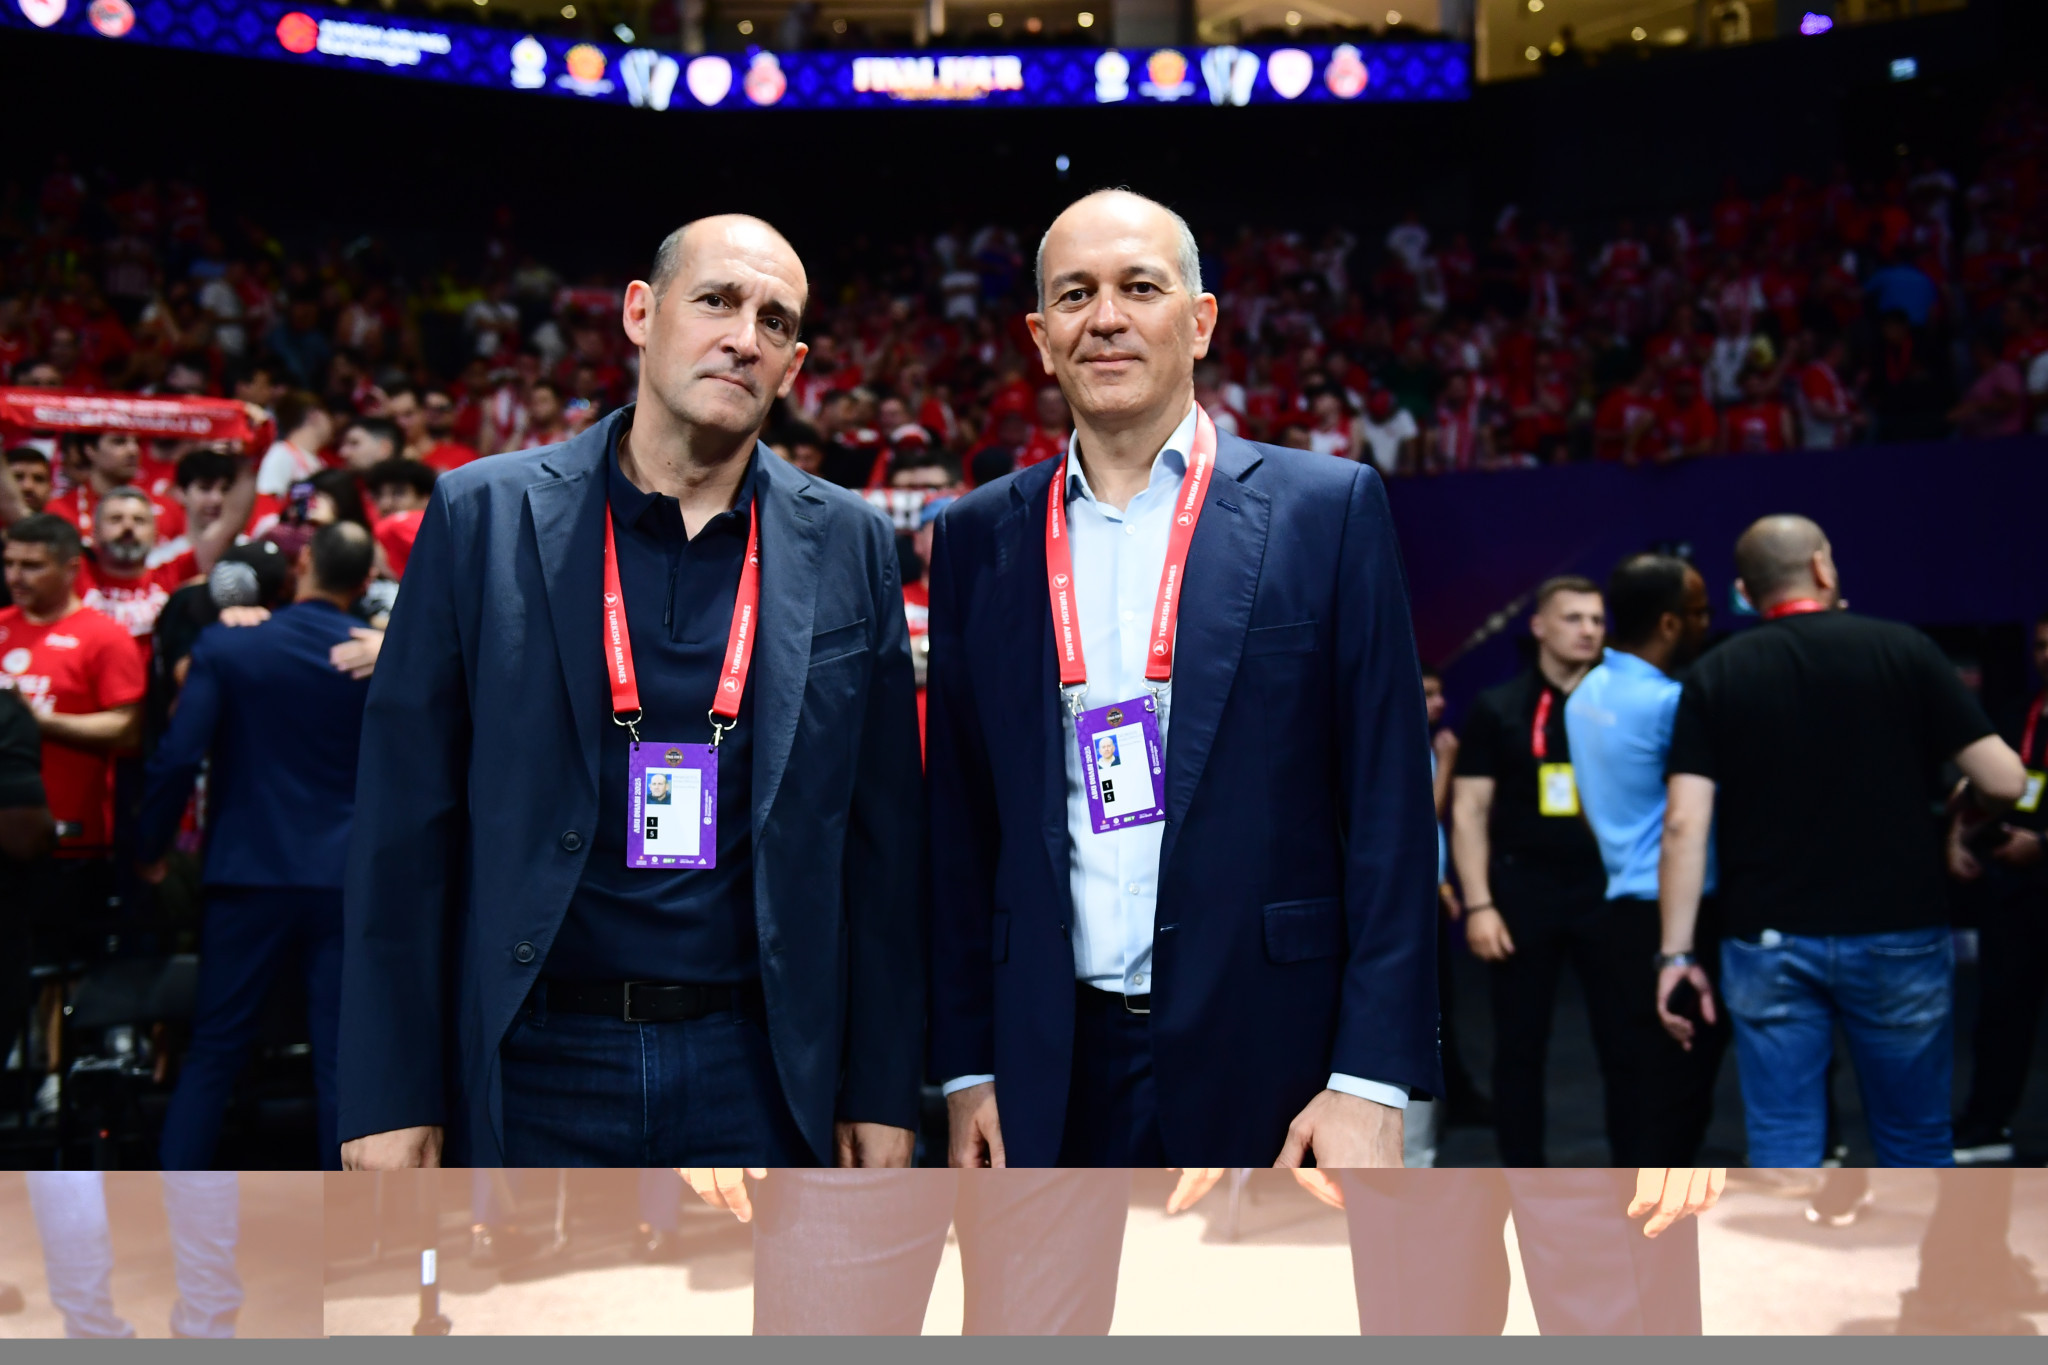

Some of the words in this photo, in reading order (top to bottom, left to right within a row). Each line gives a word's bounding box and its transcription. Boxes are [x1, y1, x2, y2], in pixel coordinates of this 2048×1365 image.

[1184, 480, 1200, 510] TURKISH
[1052, 507, 1060, 539] AIRLINES
[1164, 565, 1177, 600] AIRLINES
[737, 605, 752, 640] AIRLINES
[1058, 590, 1070, 625] TURKISH
[1159, 601, 1171, 637] TURKISH
[608, 609, 621, 645] TURKISH
[1063, 625, 1075, 662] AIRLINES
[614, 646, 627, 685] AIRLINES
[731, 640, 745, 674] TURKISH
[634, 777, 642, 796] 2025
[1090, 785, 1099, 800] ABU
